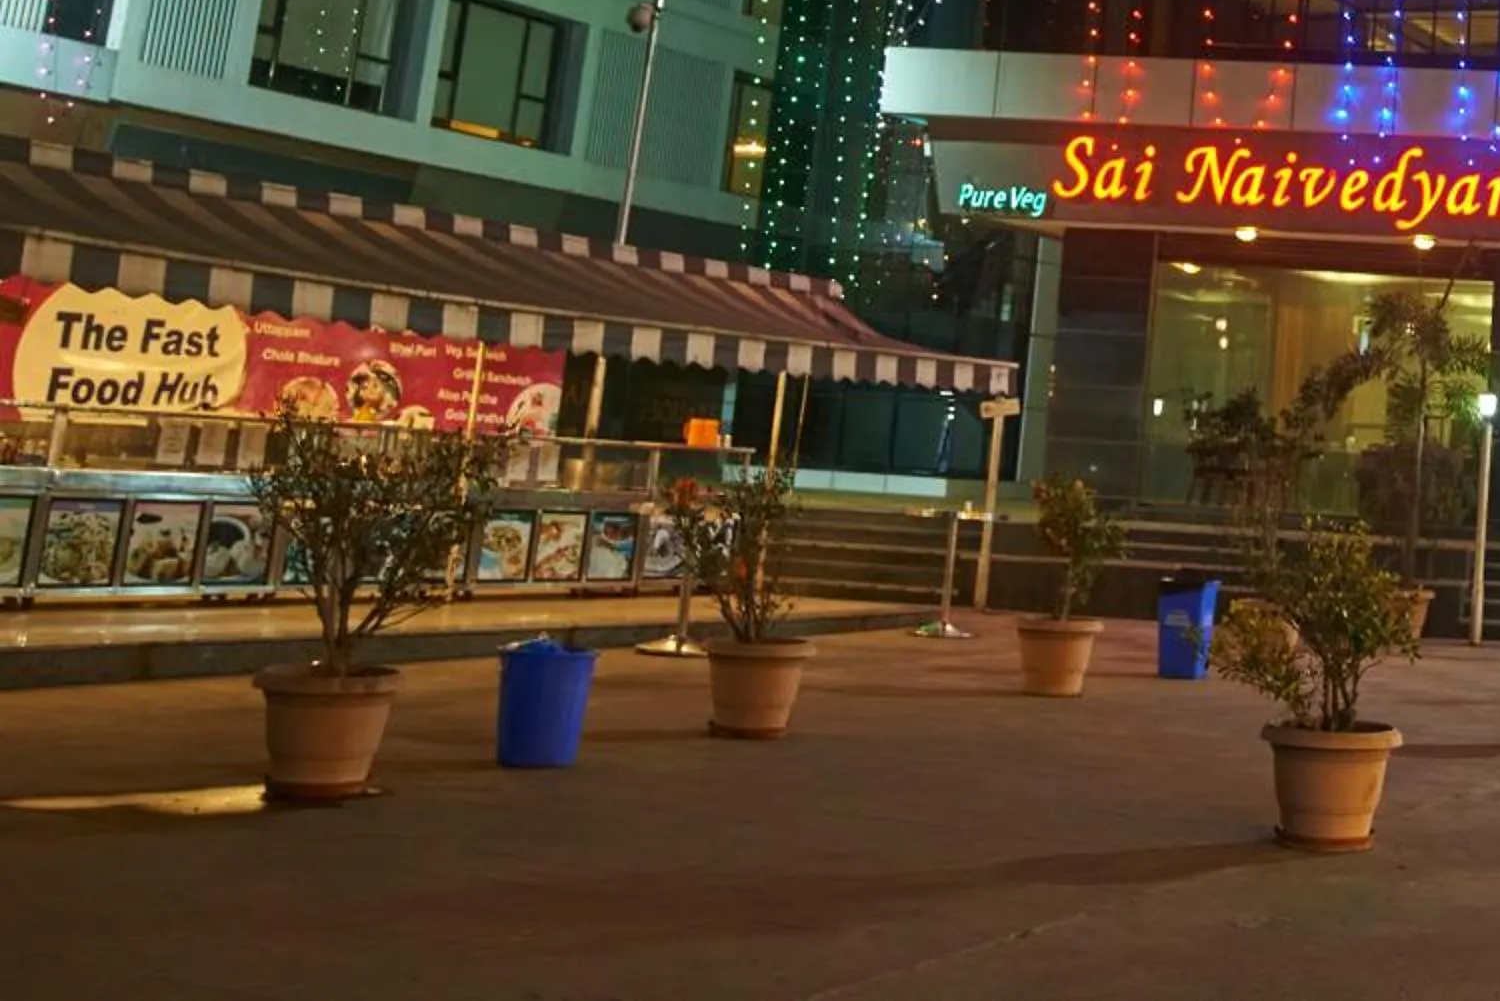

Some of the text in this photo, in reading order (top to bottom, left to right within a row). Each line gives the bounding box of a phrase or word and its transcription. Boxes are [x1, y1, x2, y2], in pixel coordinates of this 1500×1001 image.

[1053, 135, 1158, 201] Sai
[959, 183, 1047, 218] Pure Veg
[56, 311, 221, 358] The Fast
[46, 368, 219, 406] Food Hub
